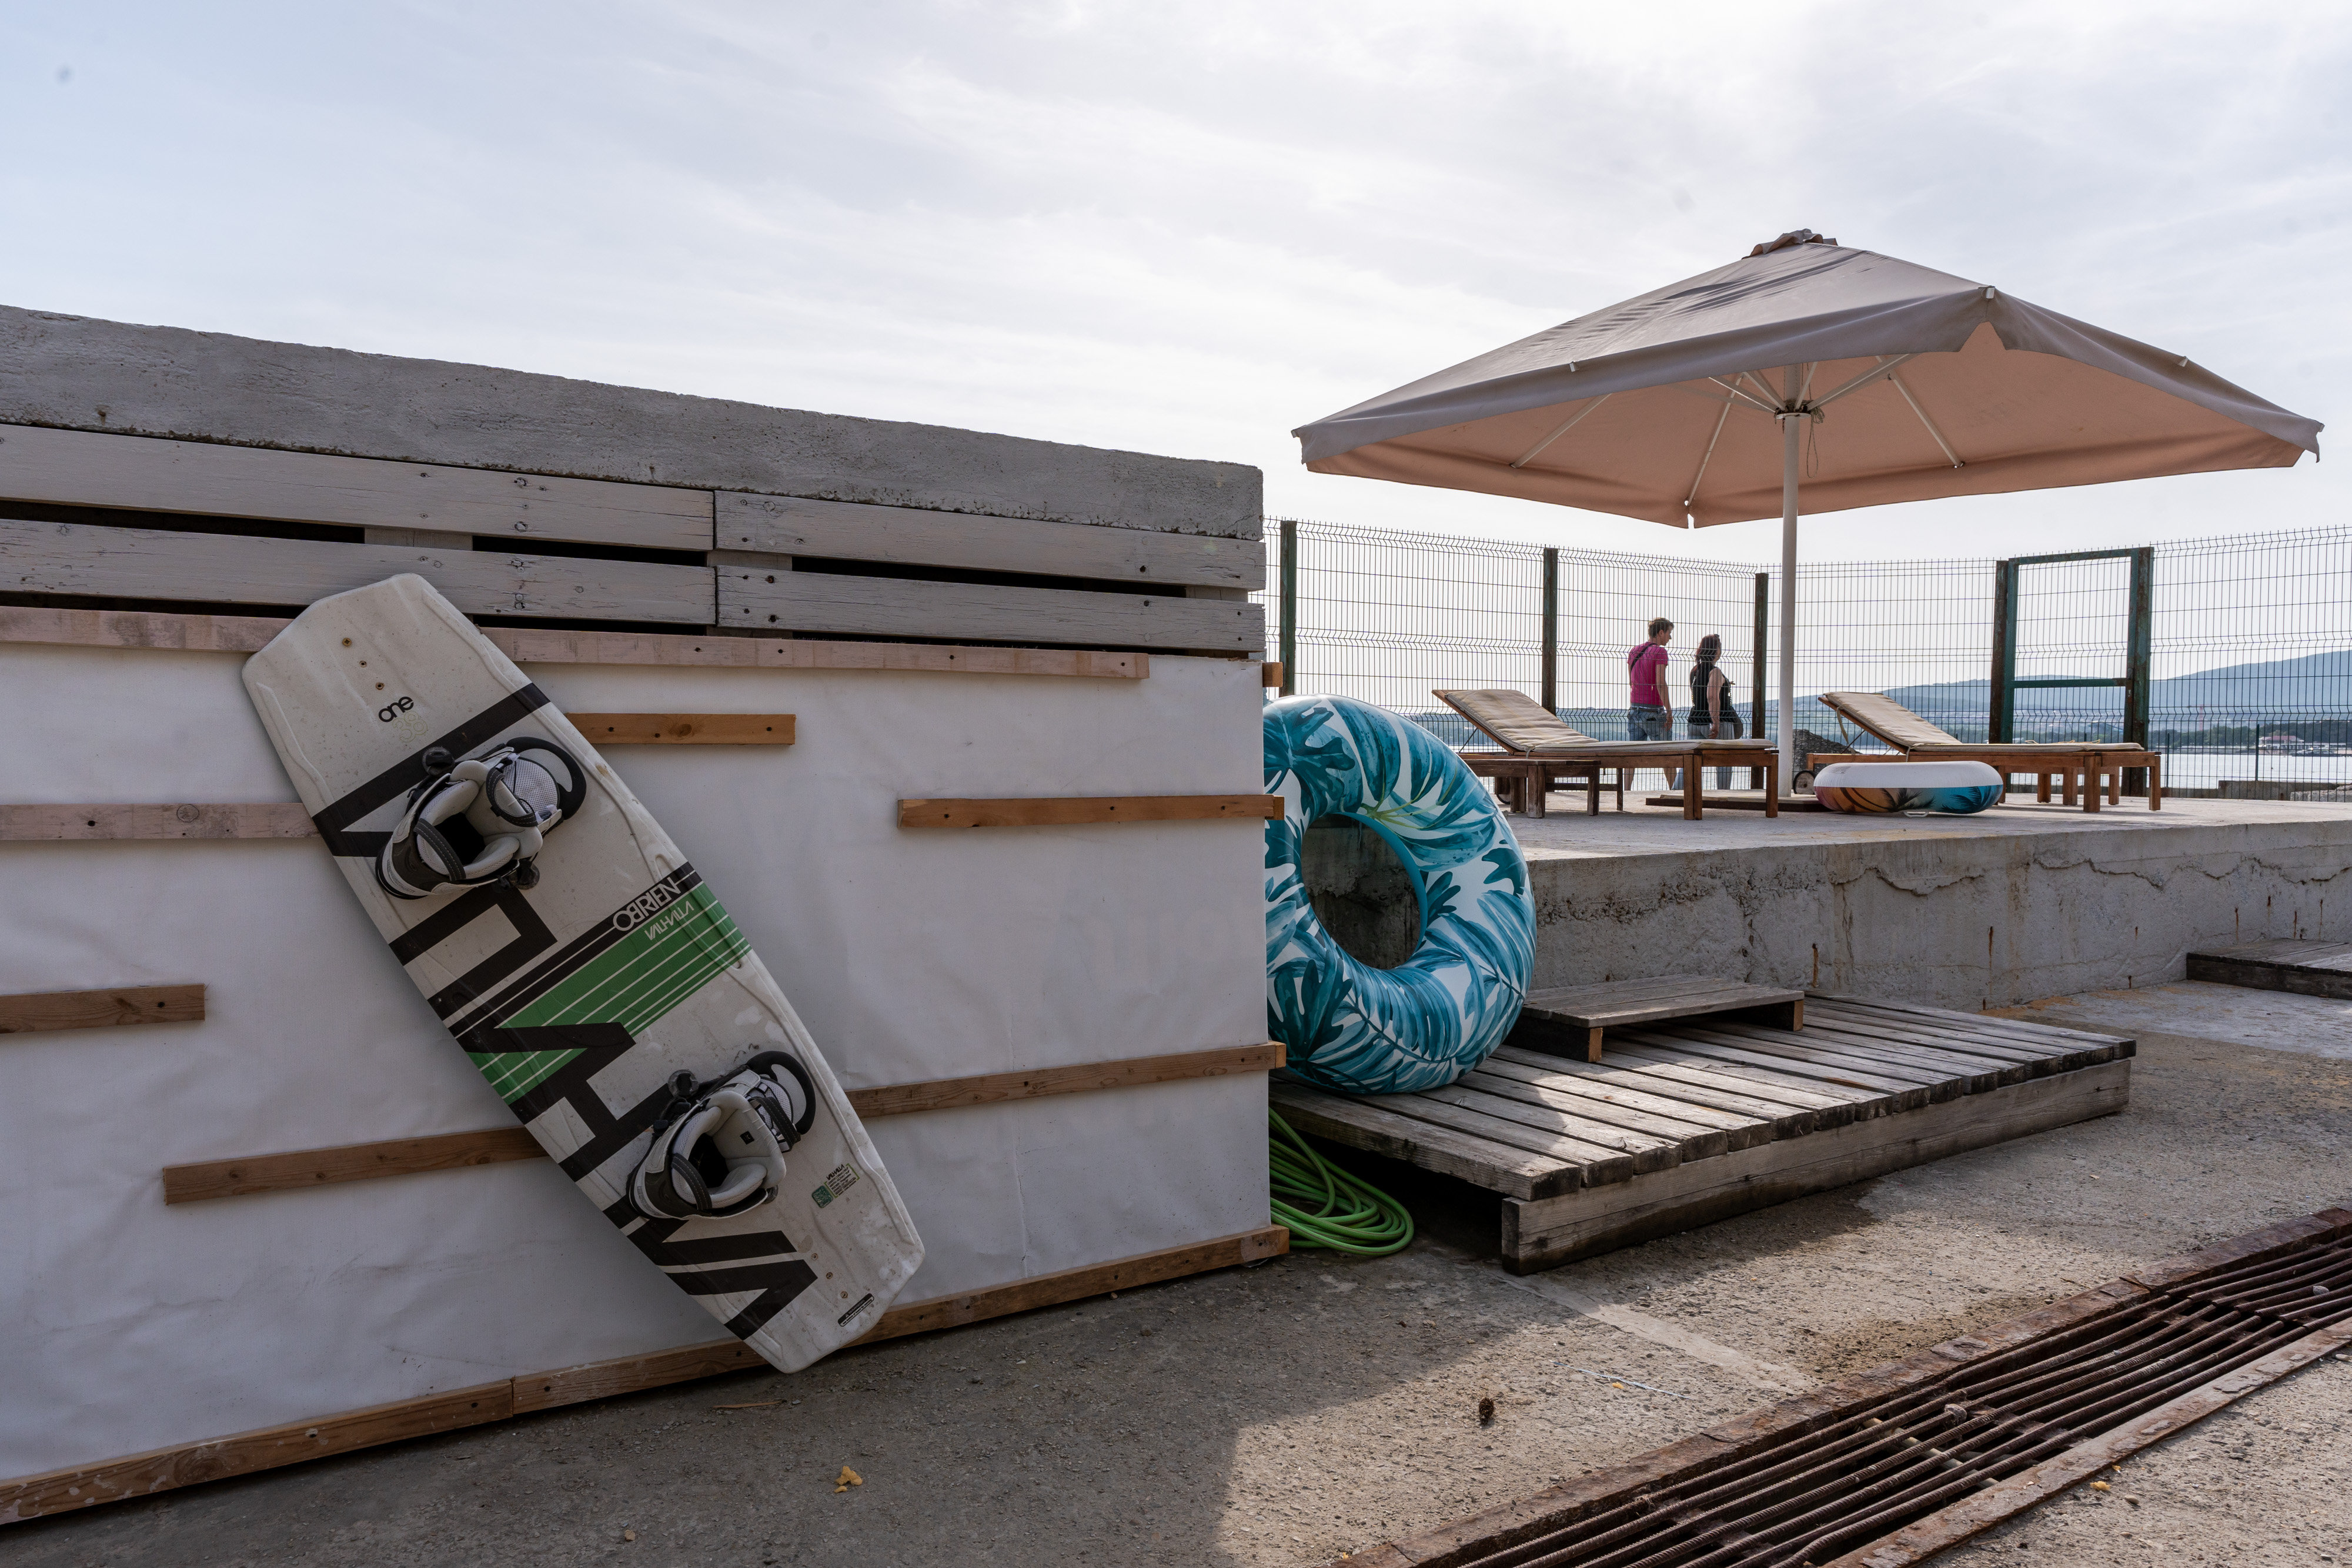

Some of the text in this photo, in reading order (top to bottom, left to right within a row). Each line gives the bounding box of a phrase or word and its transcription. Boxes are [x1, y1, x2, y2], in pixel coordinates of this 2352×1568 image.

[379, 697, 414, 723] one
[613, 877, 681, 931] OBRIEN
[644, 901, 694, 941] VALHALLA
[312, 682, 818, 1340] VAHALLA
[826, 1164, 845, 1181] VALHALLA
